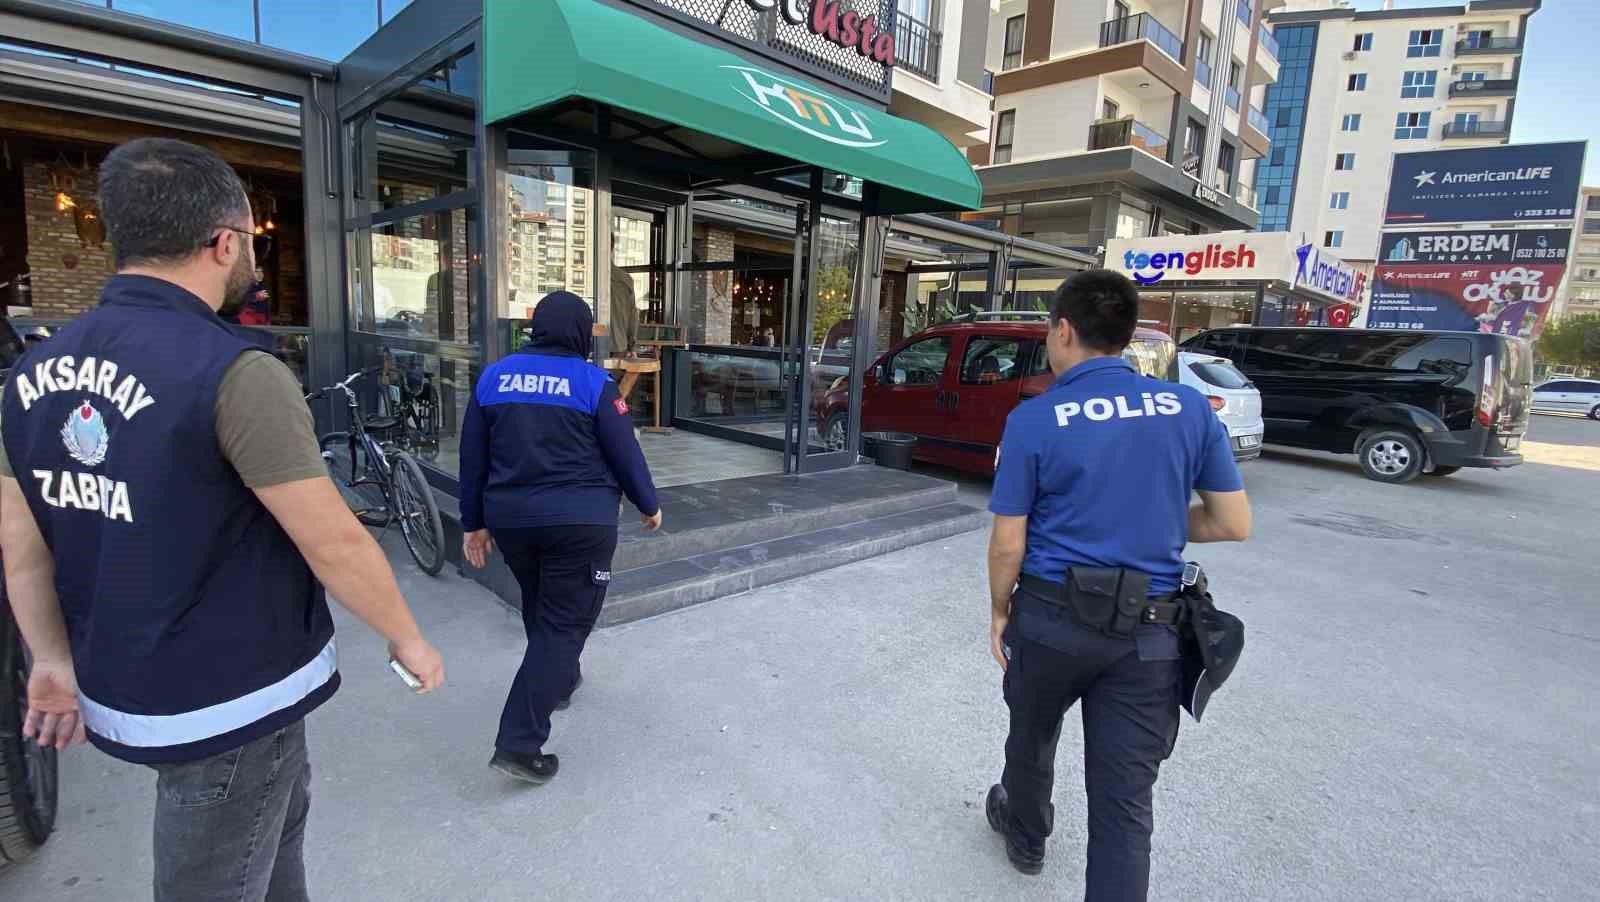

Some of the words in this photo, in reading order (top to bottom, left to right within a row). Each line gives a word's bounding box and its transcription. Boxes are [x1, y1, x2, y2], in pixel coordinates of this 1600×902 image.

[1441, 166, 1552, 184] AmericanLIFE
[1418, 234, 1510, 253] ERDEM
[16, 356, 155, 420] AKSARAY
[498, 374, 571, 396] ZABITA
[32, 470, 134, 523] ZABITA
